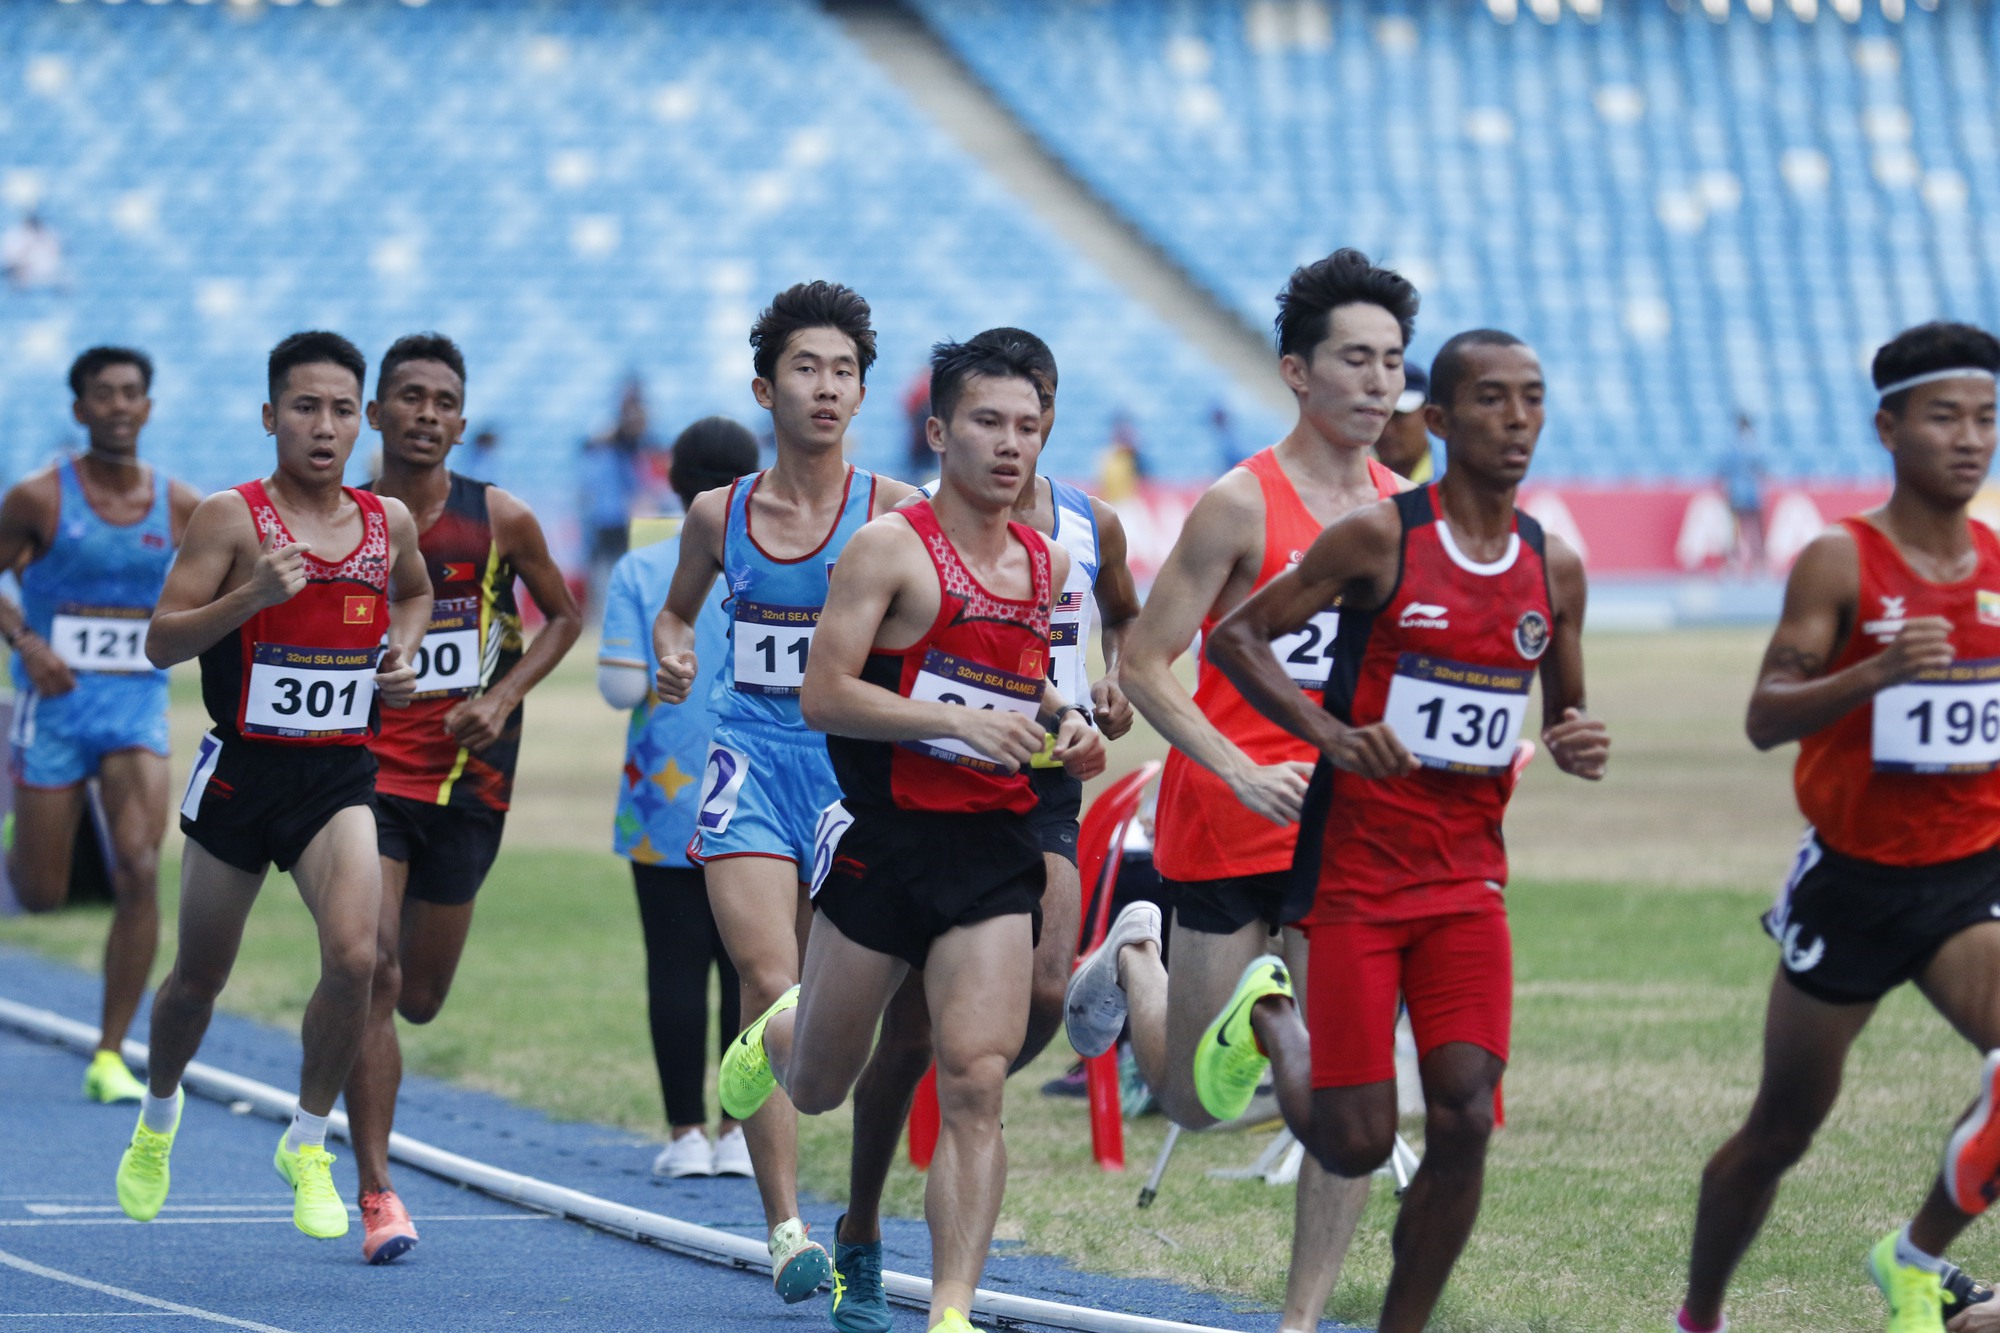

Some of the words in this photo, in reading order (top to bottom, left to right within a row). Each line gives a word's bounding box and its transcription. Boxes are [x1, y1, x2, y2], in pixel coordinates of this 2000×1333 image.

[761, 609, 785, 620] 32nd
[787, 612, 809, 621] SEA
[73, 628, 141, 657] 121
[286, 653, 312, 664] 32nd
[314, 655, 334, 665] SEA
[335, 655, 368, 665] GAMES
[755, 635, 809, 674] 11
[271, 677, 357, 718] 301
[956, 666, 982, 682] 32nd
[984, 674, 1003, 687] SEA
[1005, 681, 1037, 696] GAMES
[1466, 672, 1489, 686] SEA
[1417, 697, 1510, 751] 130
[1907, 699, 2000, 746] 196
[181, 736, 218, 810] 7
[701, 748, 737, 829] 2
